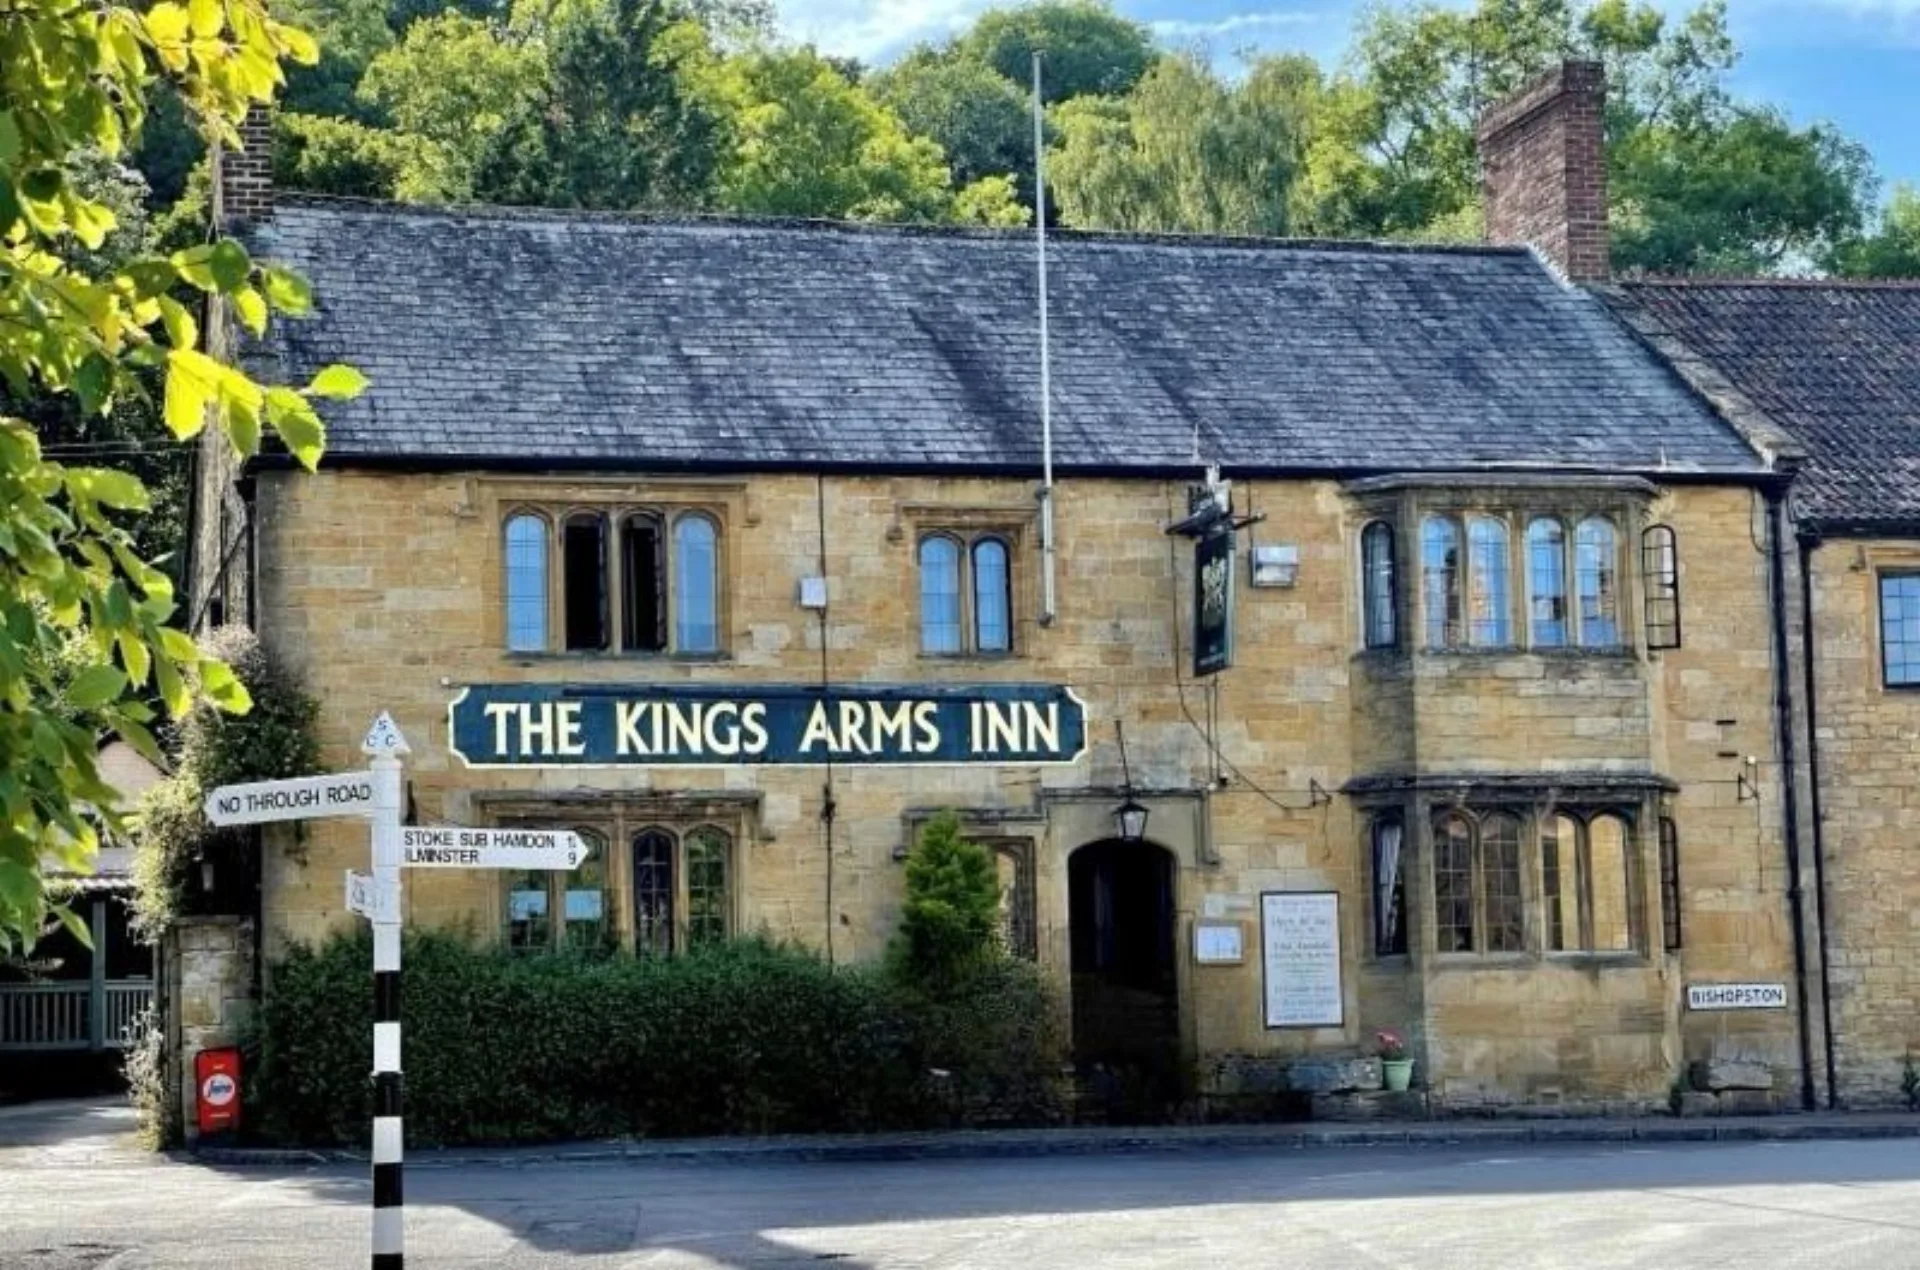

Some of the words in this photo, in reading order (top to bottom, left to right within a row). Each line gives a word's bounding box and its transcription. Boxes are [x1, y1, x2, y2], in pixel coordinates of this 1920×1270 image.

[484, 701, 586, 755] THE
[615, 700, 768, 755] KINGS
[799, 700, 940, 755] ARMS
[971, 701, 1059, 753] INN
[217, 796, 241, 815] NO
[246, 788, 320, 813] THROUGH
[327, 783, 373, 804] ROAD
[404, 830, 454, 847] STOKE
[460, 832, 488, 847] SUB
[494, 832, 555, 848] HAMDON
[404, 849, 480, 864] ILMINSTER
[568, 851, 576, 865] 9
[1691, 988, 1783, 1004] BISHOPSTON
